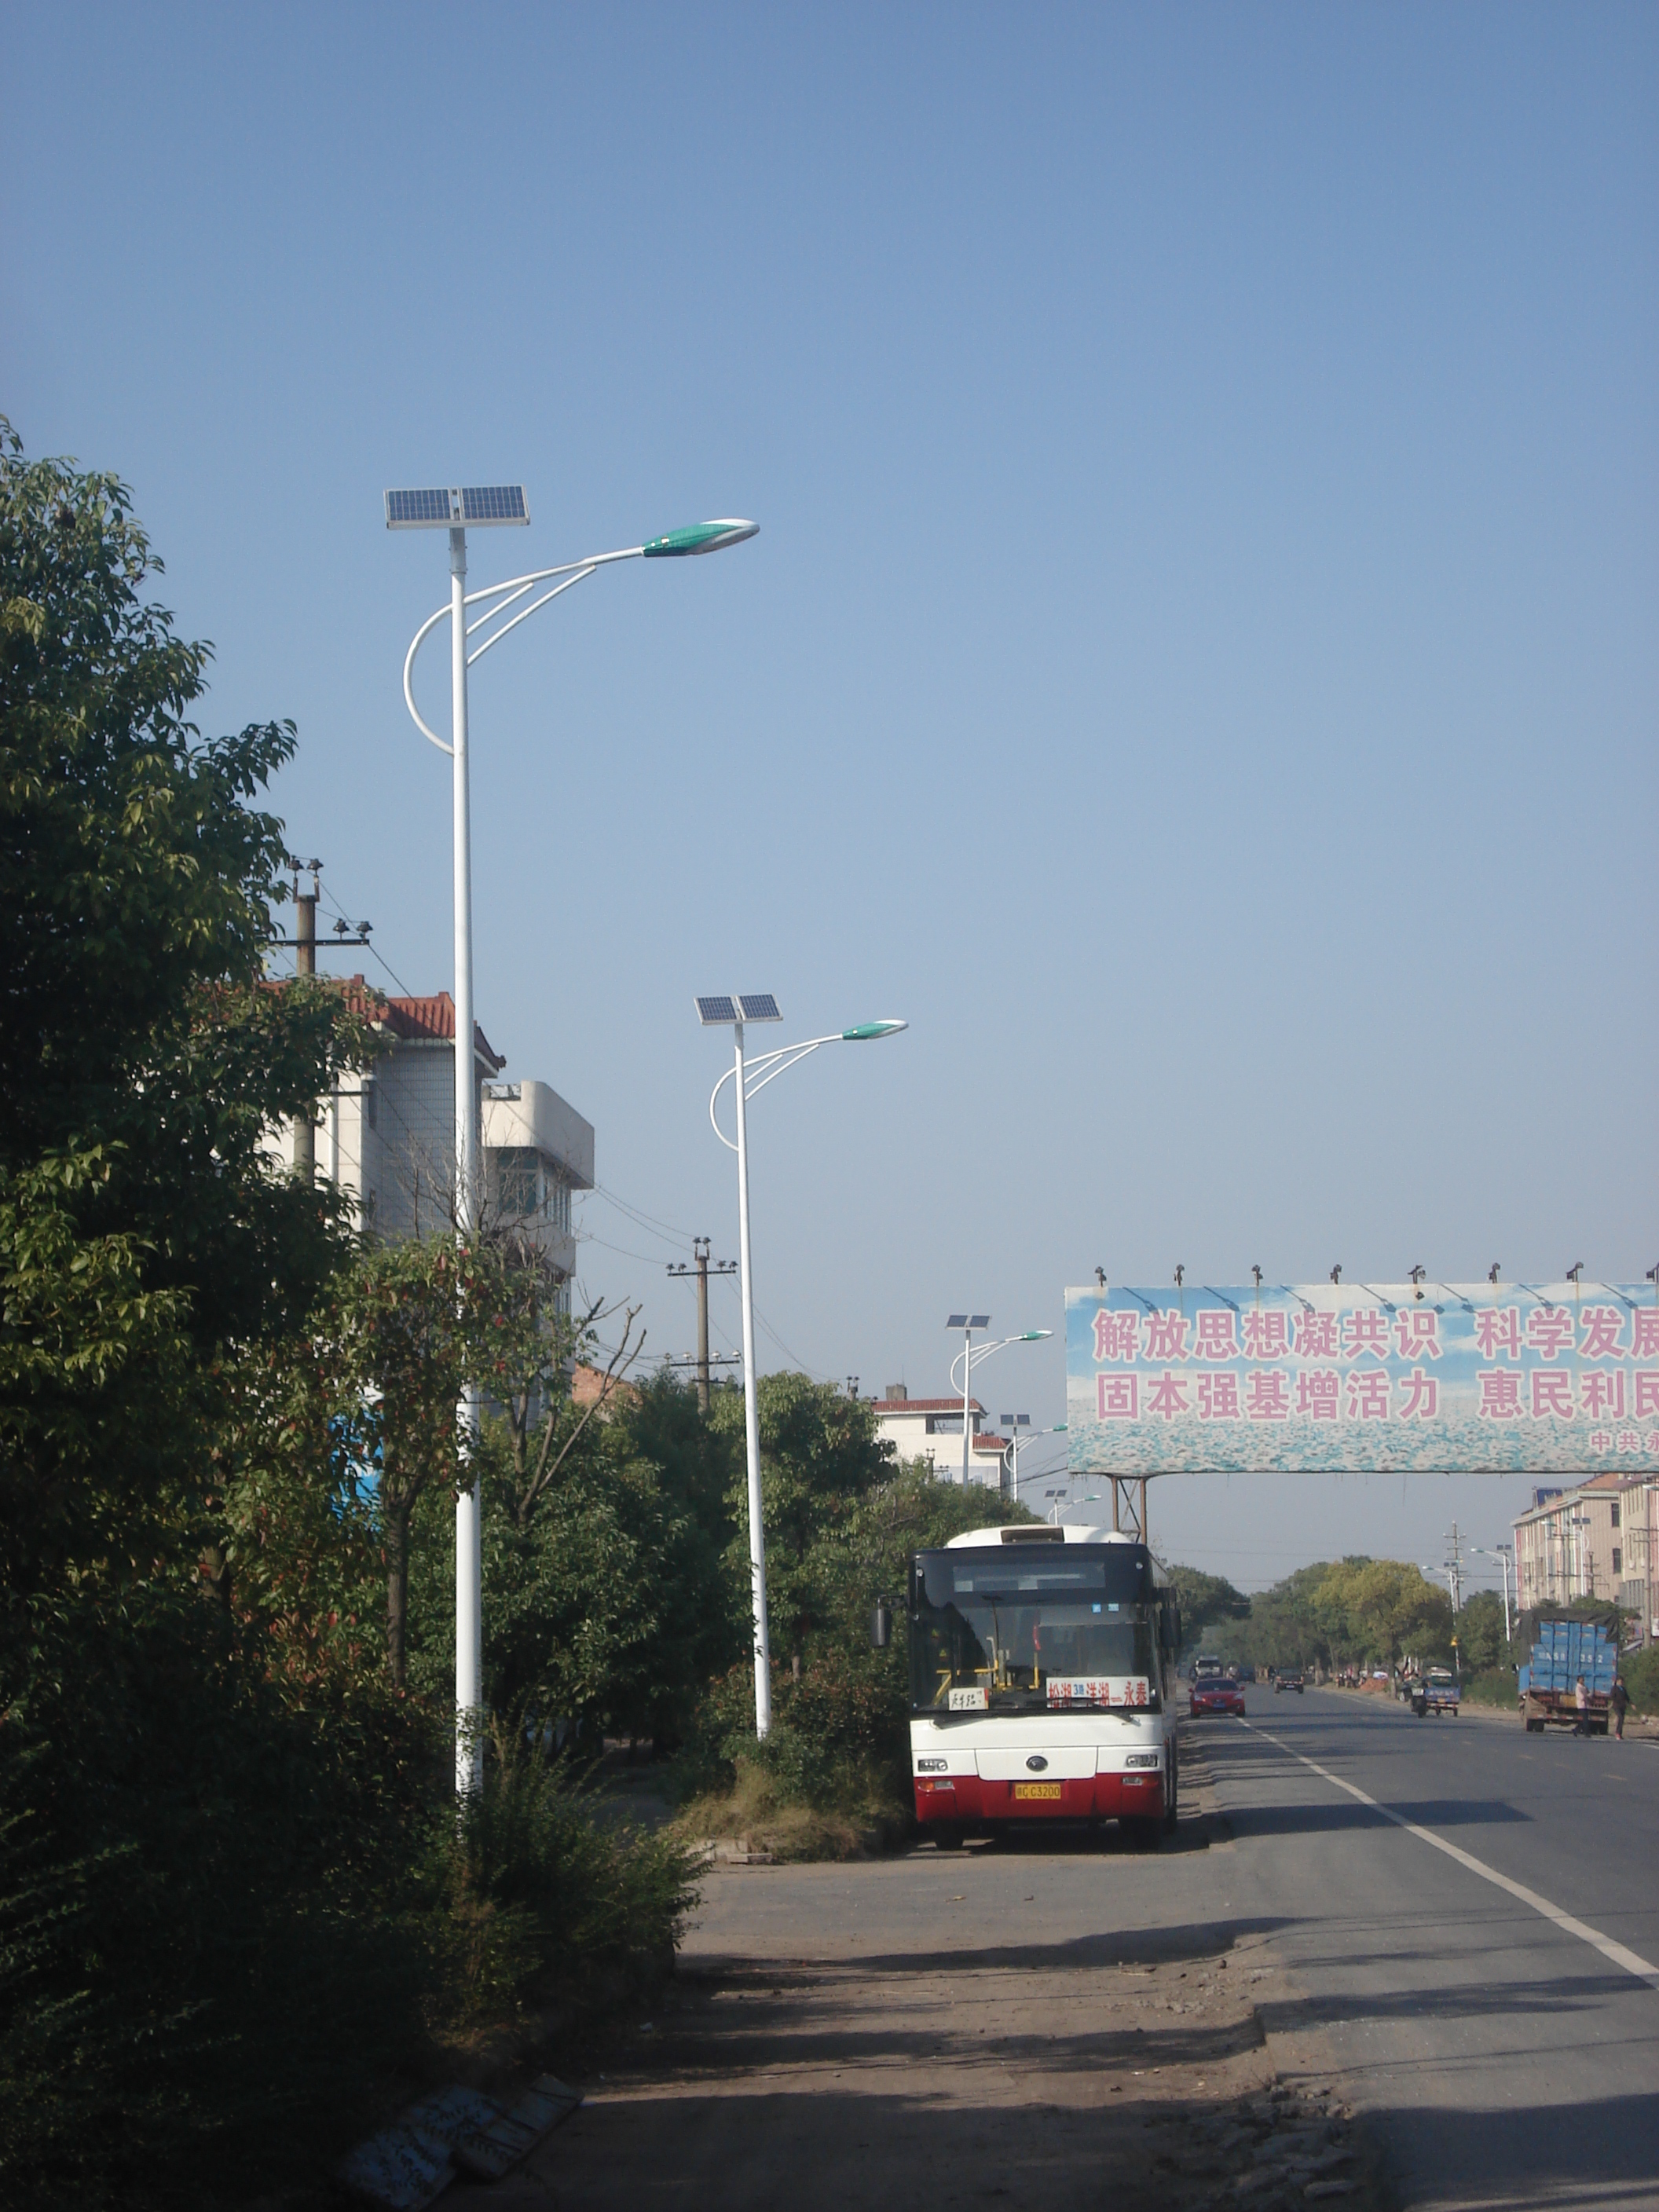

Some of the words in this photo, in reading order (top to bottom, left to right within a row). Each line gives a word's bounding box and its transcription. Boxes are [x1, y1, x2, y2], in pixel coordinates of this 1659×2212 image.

[1093, 1309, 1441, 1361] 解放思想凝共识
[1476, 1308, 1659, 1358] 科学发展
[1097, 1370, 1439, 1419] 固本强基增活力
[1478, 1369, 1659, 1419] 惠民利民
